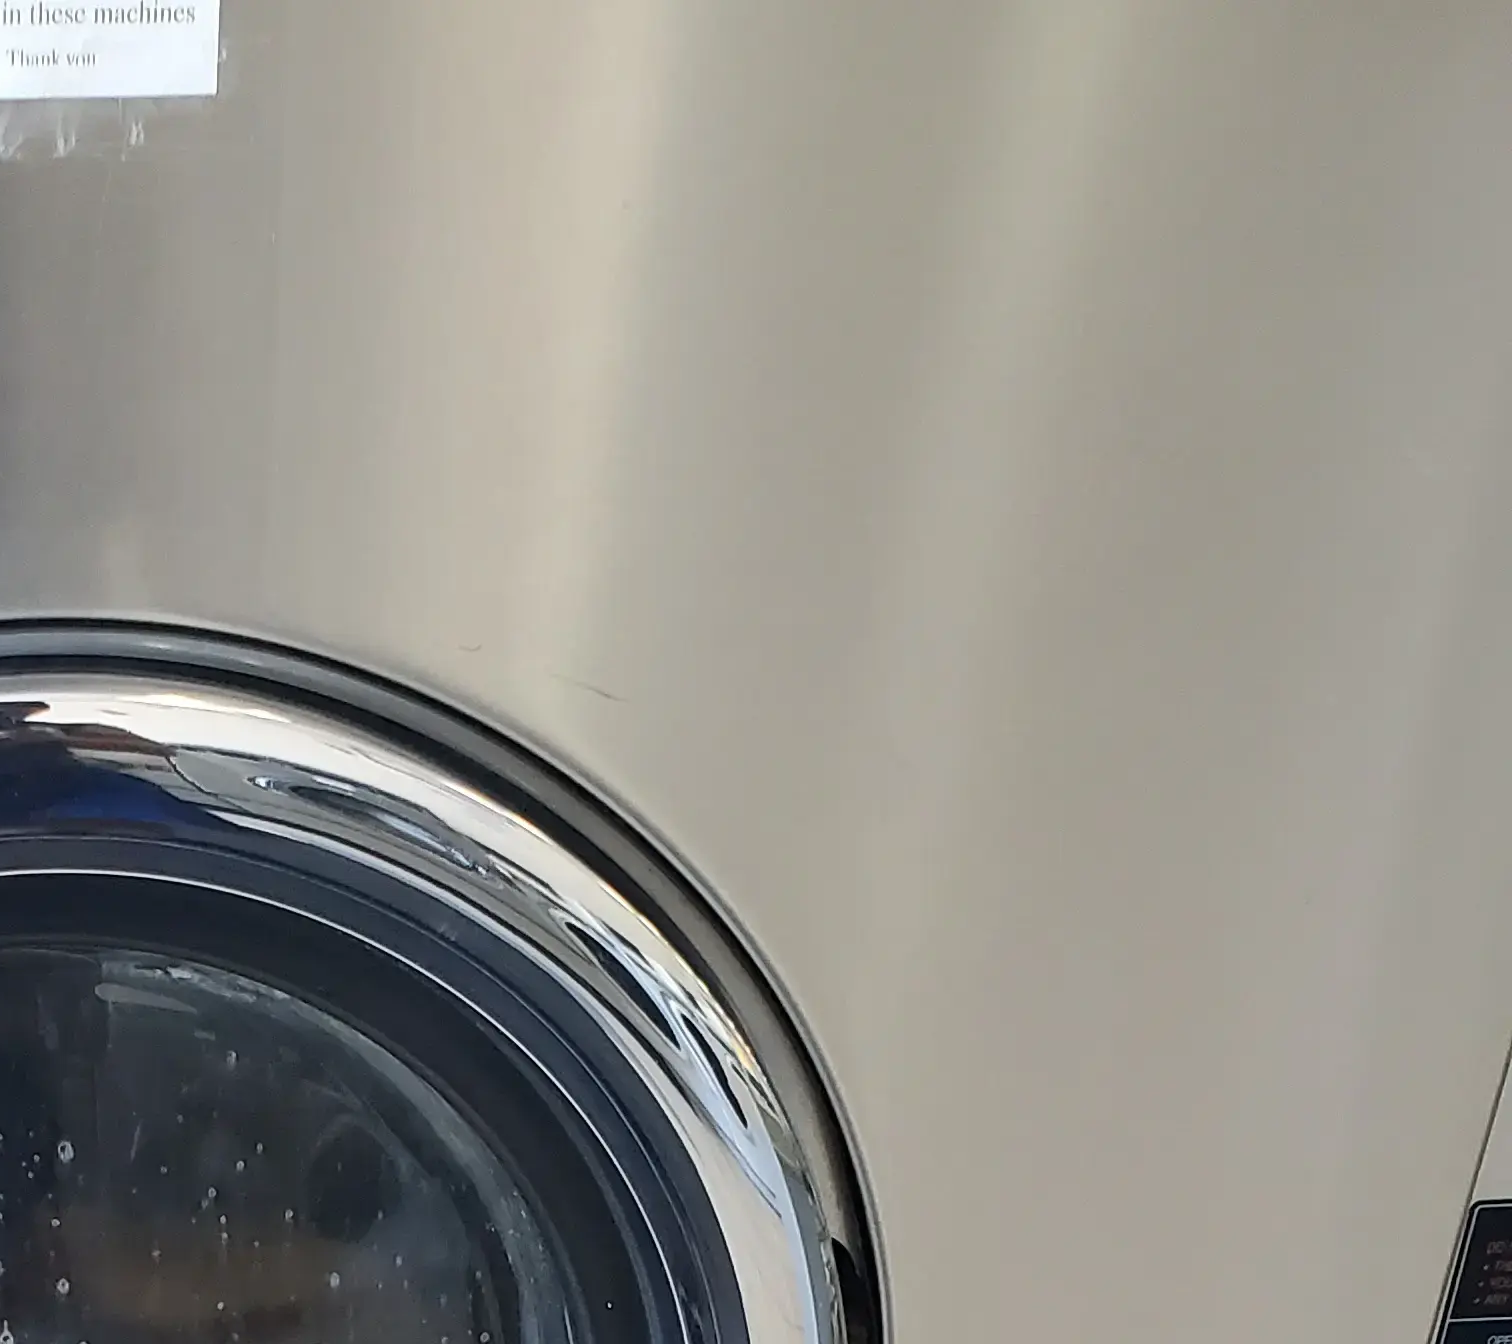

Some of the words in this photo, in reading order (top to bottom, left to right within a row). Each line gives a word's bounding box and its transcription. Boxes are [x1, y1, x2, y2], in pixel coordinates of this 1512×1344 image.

[2, 0, 21, 26] in
[30, 1, 86, 26] these
[93, 0, 196, 25] machines
[5, 48, 59, 67] Thank
